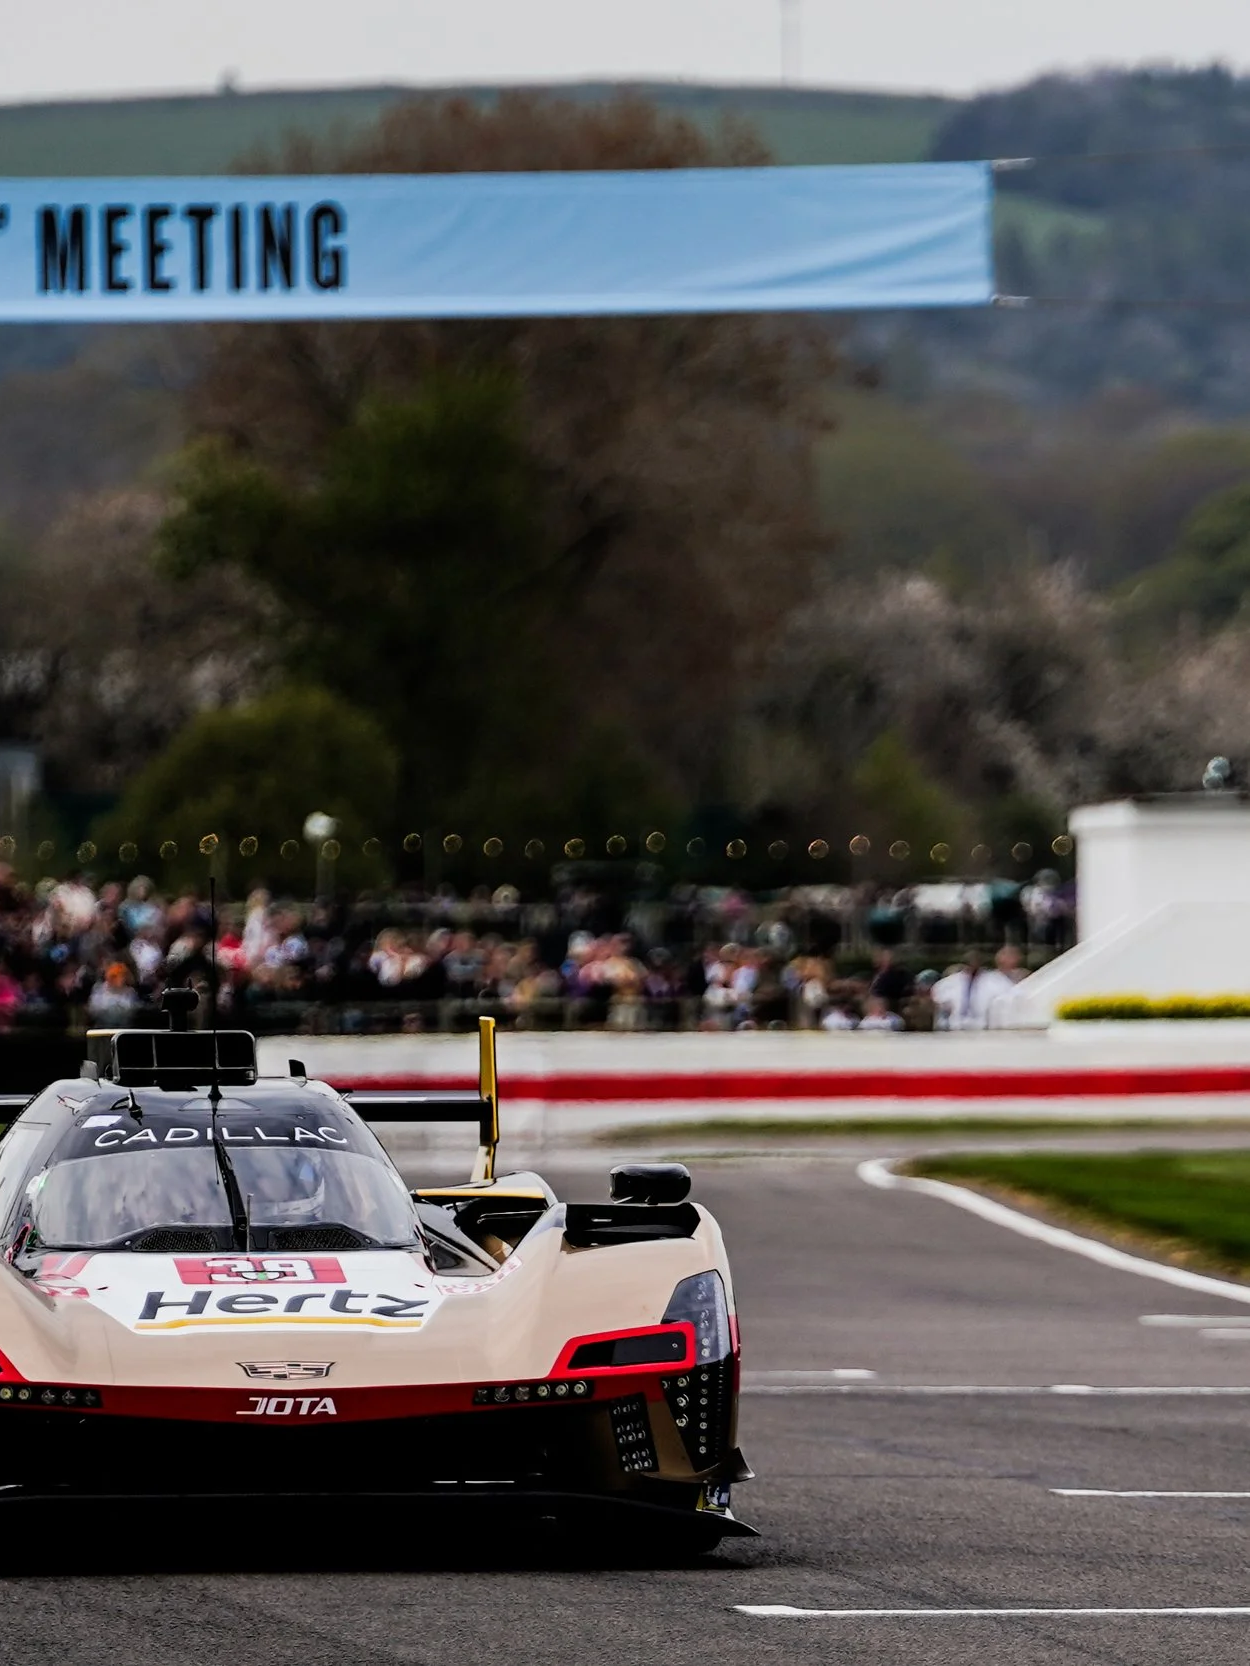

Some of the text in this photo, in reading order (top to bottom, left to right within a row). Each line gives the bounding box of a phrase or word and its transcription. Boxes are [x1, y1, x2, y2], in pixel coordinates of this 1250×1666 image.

[37, 202, 347, 295] MEETING
[94, 1127, 348, 1148] CADILLAC
[205, 1257, 317, 1284] 39
[139, 1288, 430, 1320] Hertz
[235, 1396, 338, 1416] JOTA
